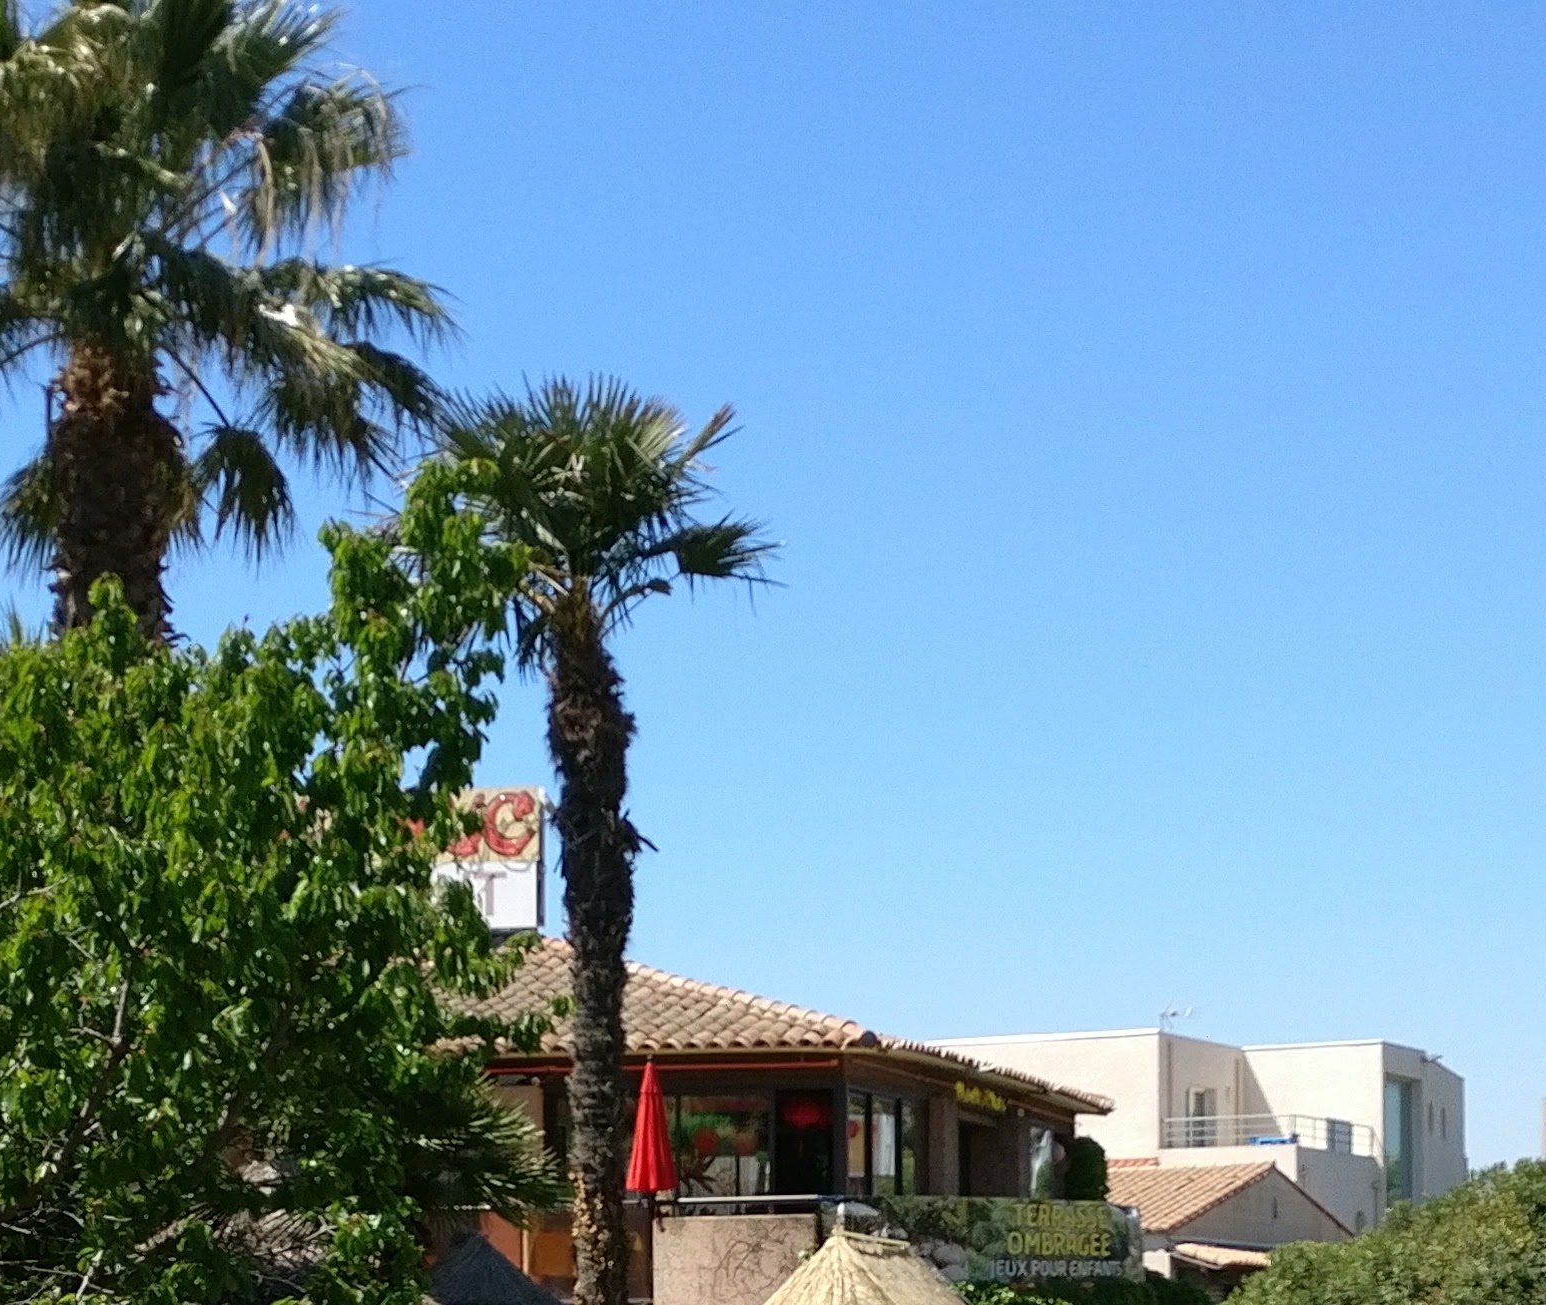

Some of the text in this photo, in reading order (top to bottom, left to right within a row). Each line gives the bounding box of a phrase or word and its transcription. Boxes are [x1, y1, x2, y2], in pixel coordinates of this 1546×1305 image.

[1012, 1203, 1108, 1229] TERRASSE
[987, 1259, 1124, 1280] JEUX POUR ENFANTS
